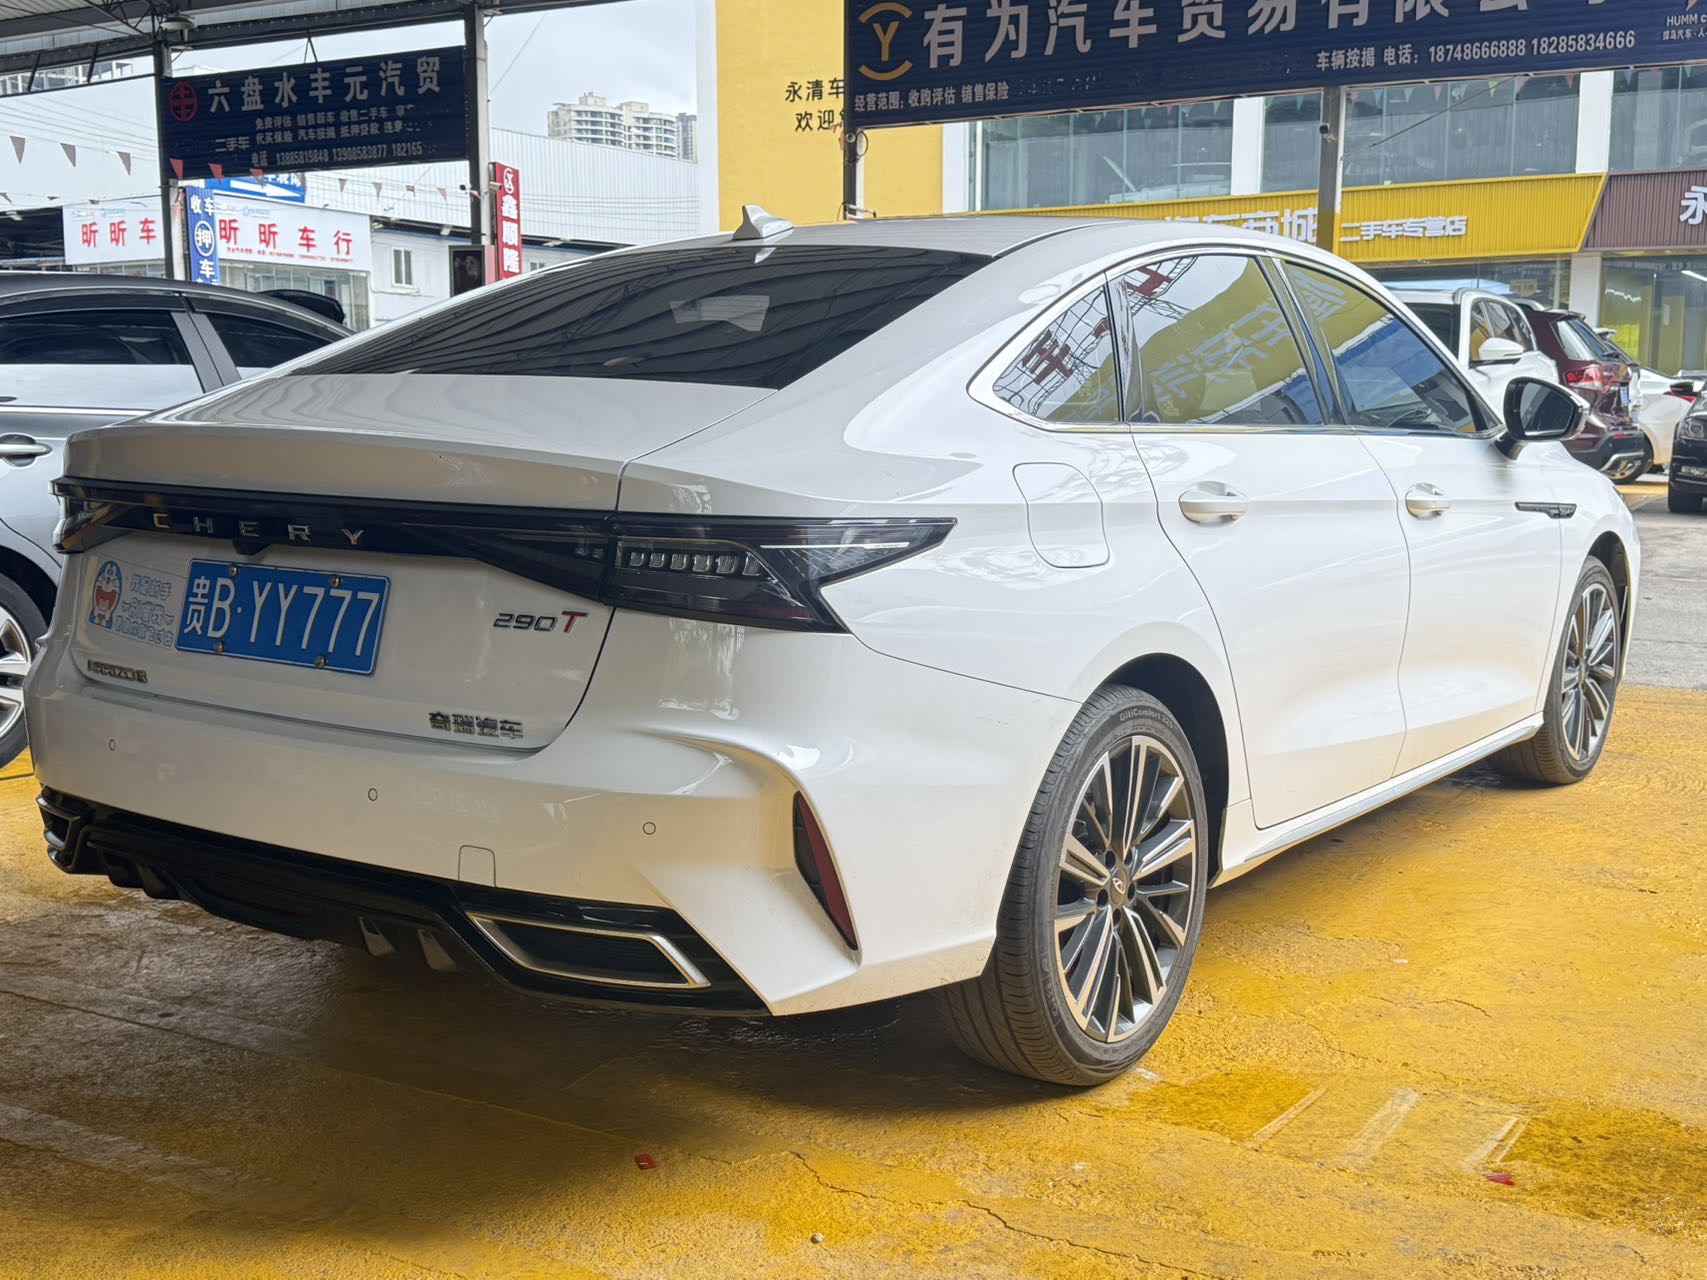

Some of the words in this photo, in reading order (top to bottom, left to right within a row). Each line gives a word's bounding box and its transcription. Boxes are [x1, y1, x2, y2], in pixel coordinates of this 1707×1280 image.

[1666, 13, 1698, 27] HUMM
[1316, 46, 1376, 72] 车辆按揭
[1428, 38, 1527, 63] 18748666888
[1531, 30, 1636, 56] 18285834666
[206, 56, 441, 113] 六盘水丰元汽贸
[907, 86, 956, 107] 收购评估
[961, 81, 1010, 103] 销售保险
[795, 109, 845, 132] 欢迎
[218, 218, 354, 257] 昕昕车行
[1339, 216, 1469, 243] 二手车专营店
[153, 512, 364, 546] CHERY
[493, 610, 590, 635] 290T
[428, 711, 525, 741] 奇瑞汽车
